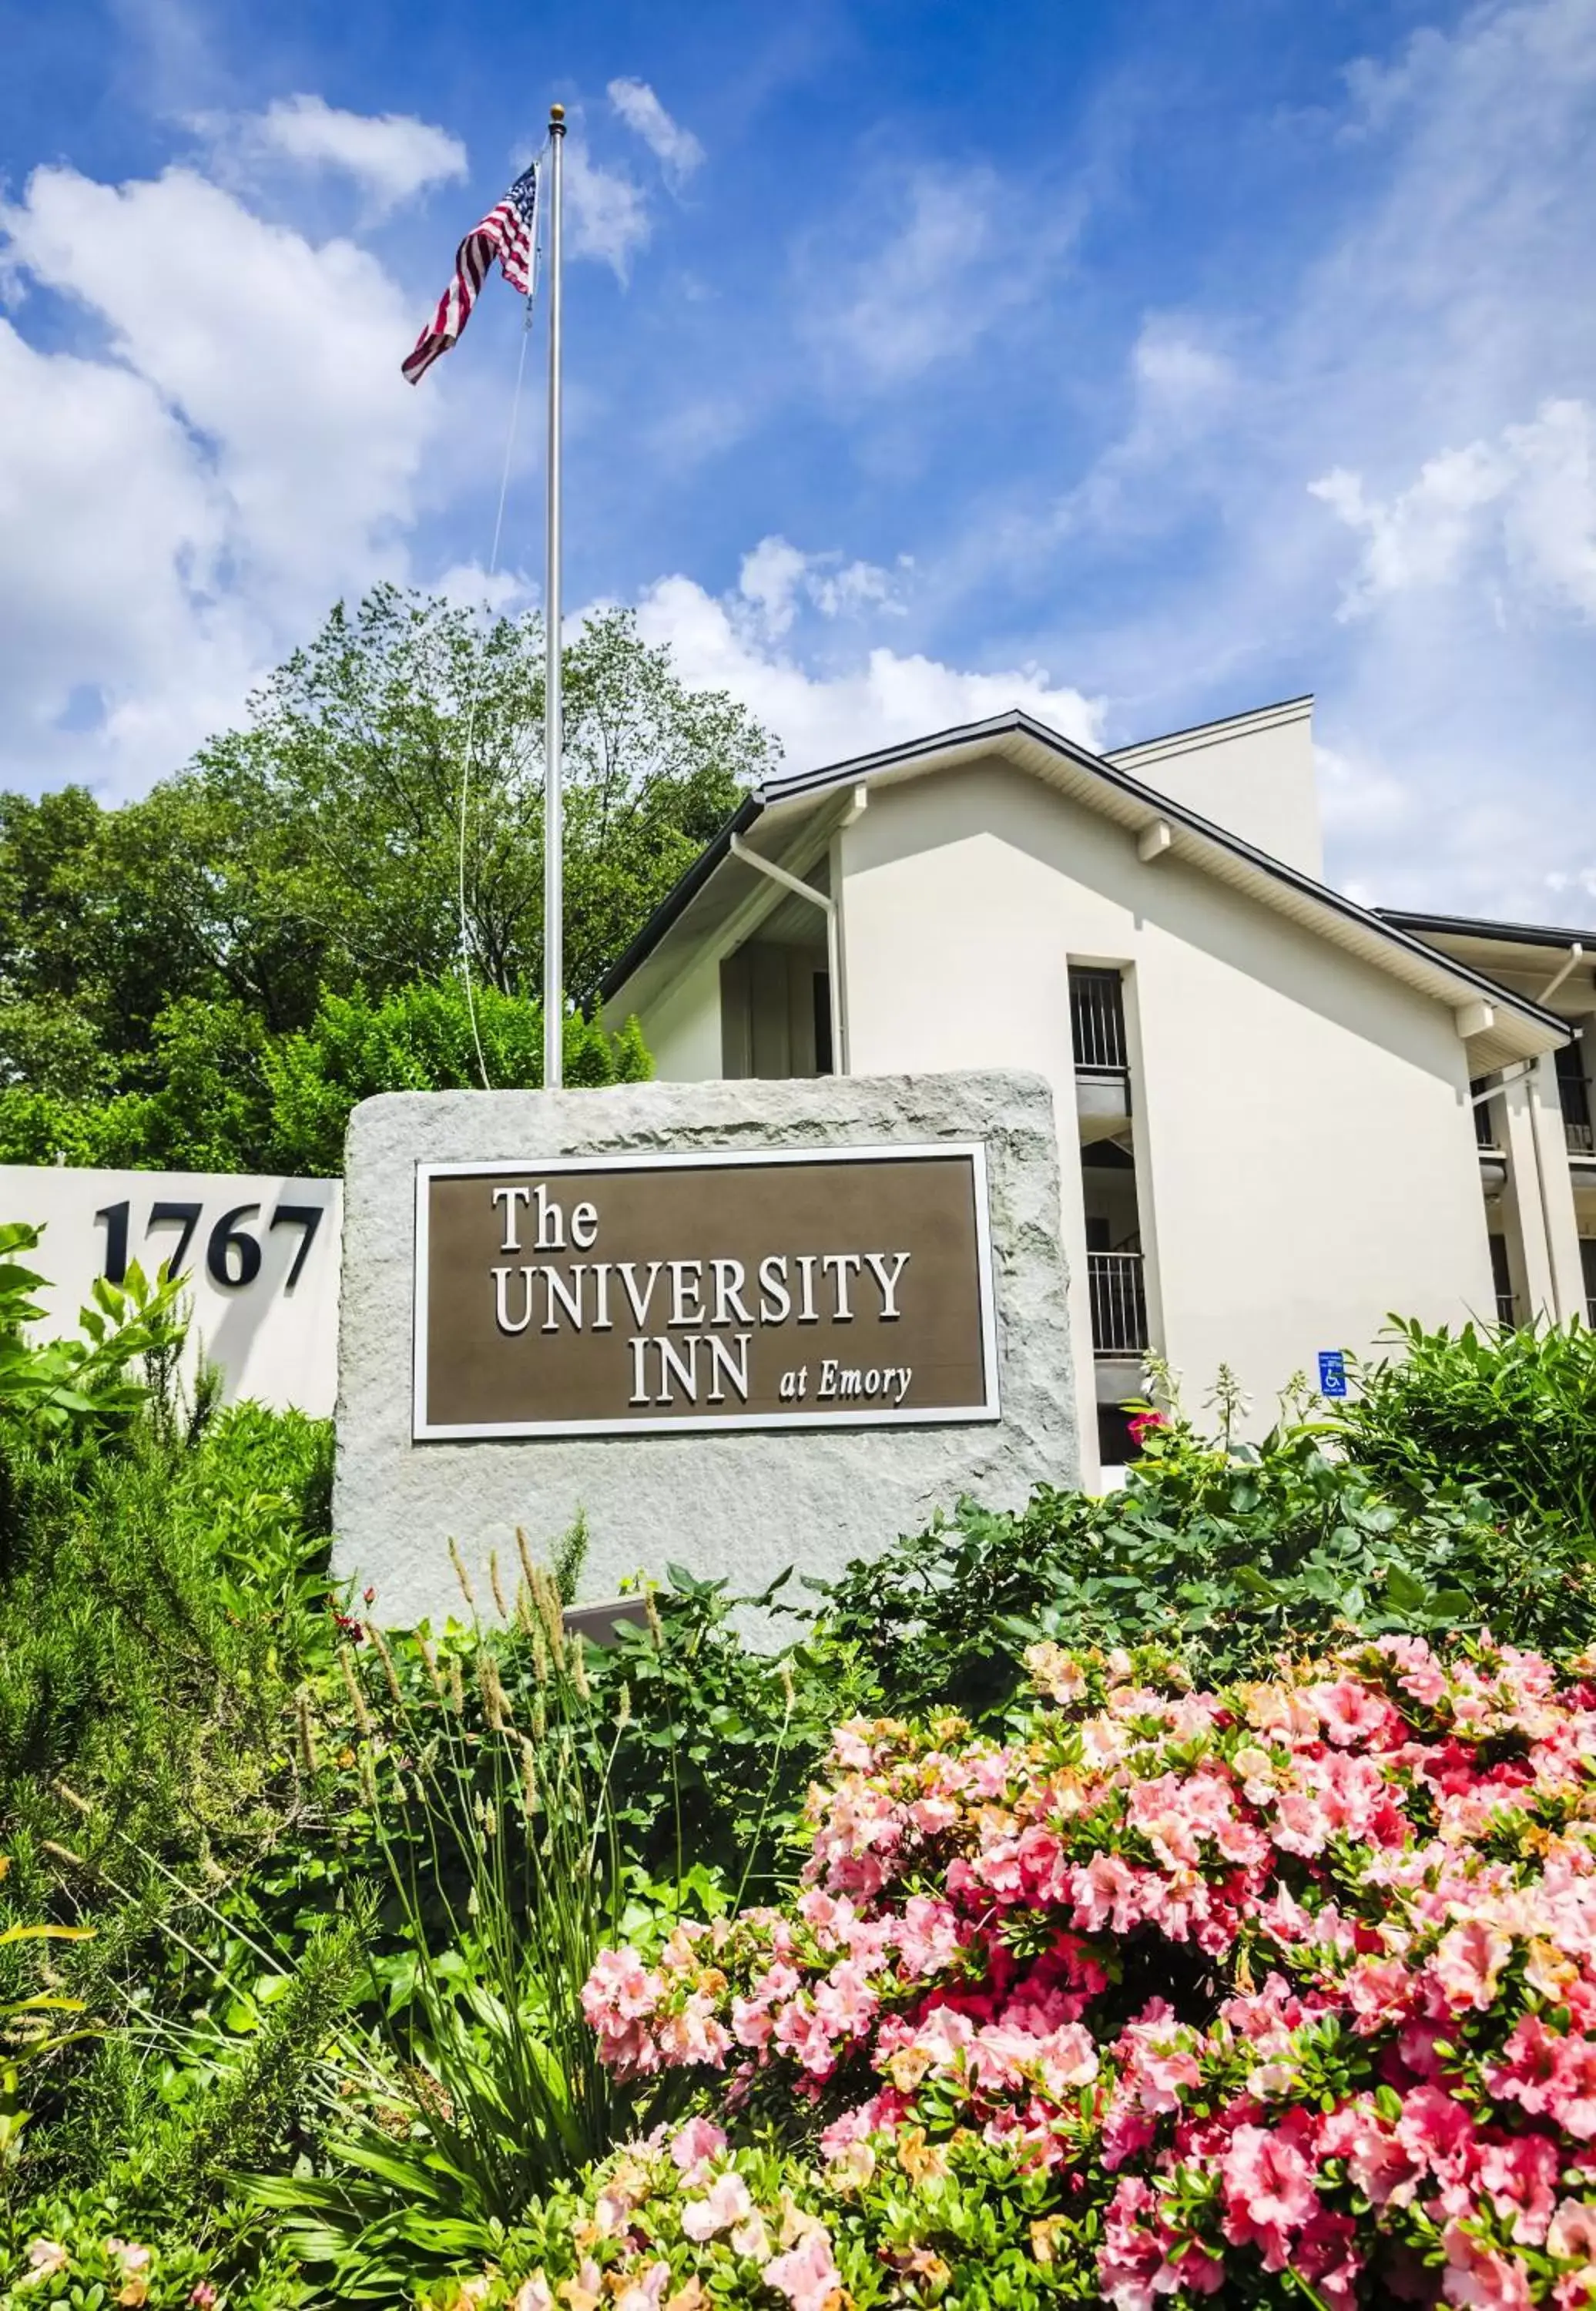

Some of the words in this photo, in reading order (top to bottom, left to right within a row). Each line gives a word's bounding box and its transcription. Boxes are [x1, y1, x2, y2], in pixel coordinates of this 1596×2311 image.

[95, 1200, 324, 1289] 1767
[492, 1184, 598, 1249] The
[491, 1252, 911, 1332] UNIVERSITY
[628, 1333, 752, 1403] INN
[779, 1364, 808, 1400] at
[817, 1359, 913, 1404] Emory
